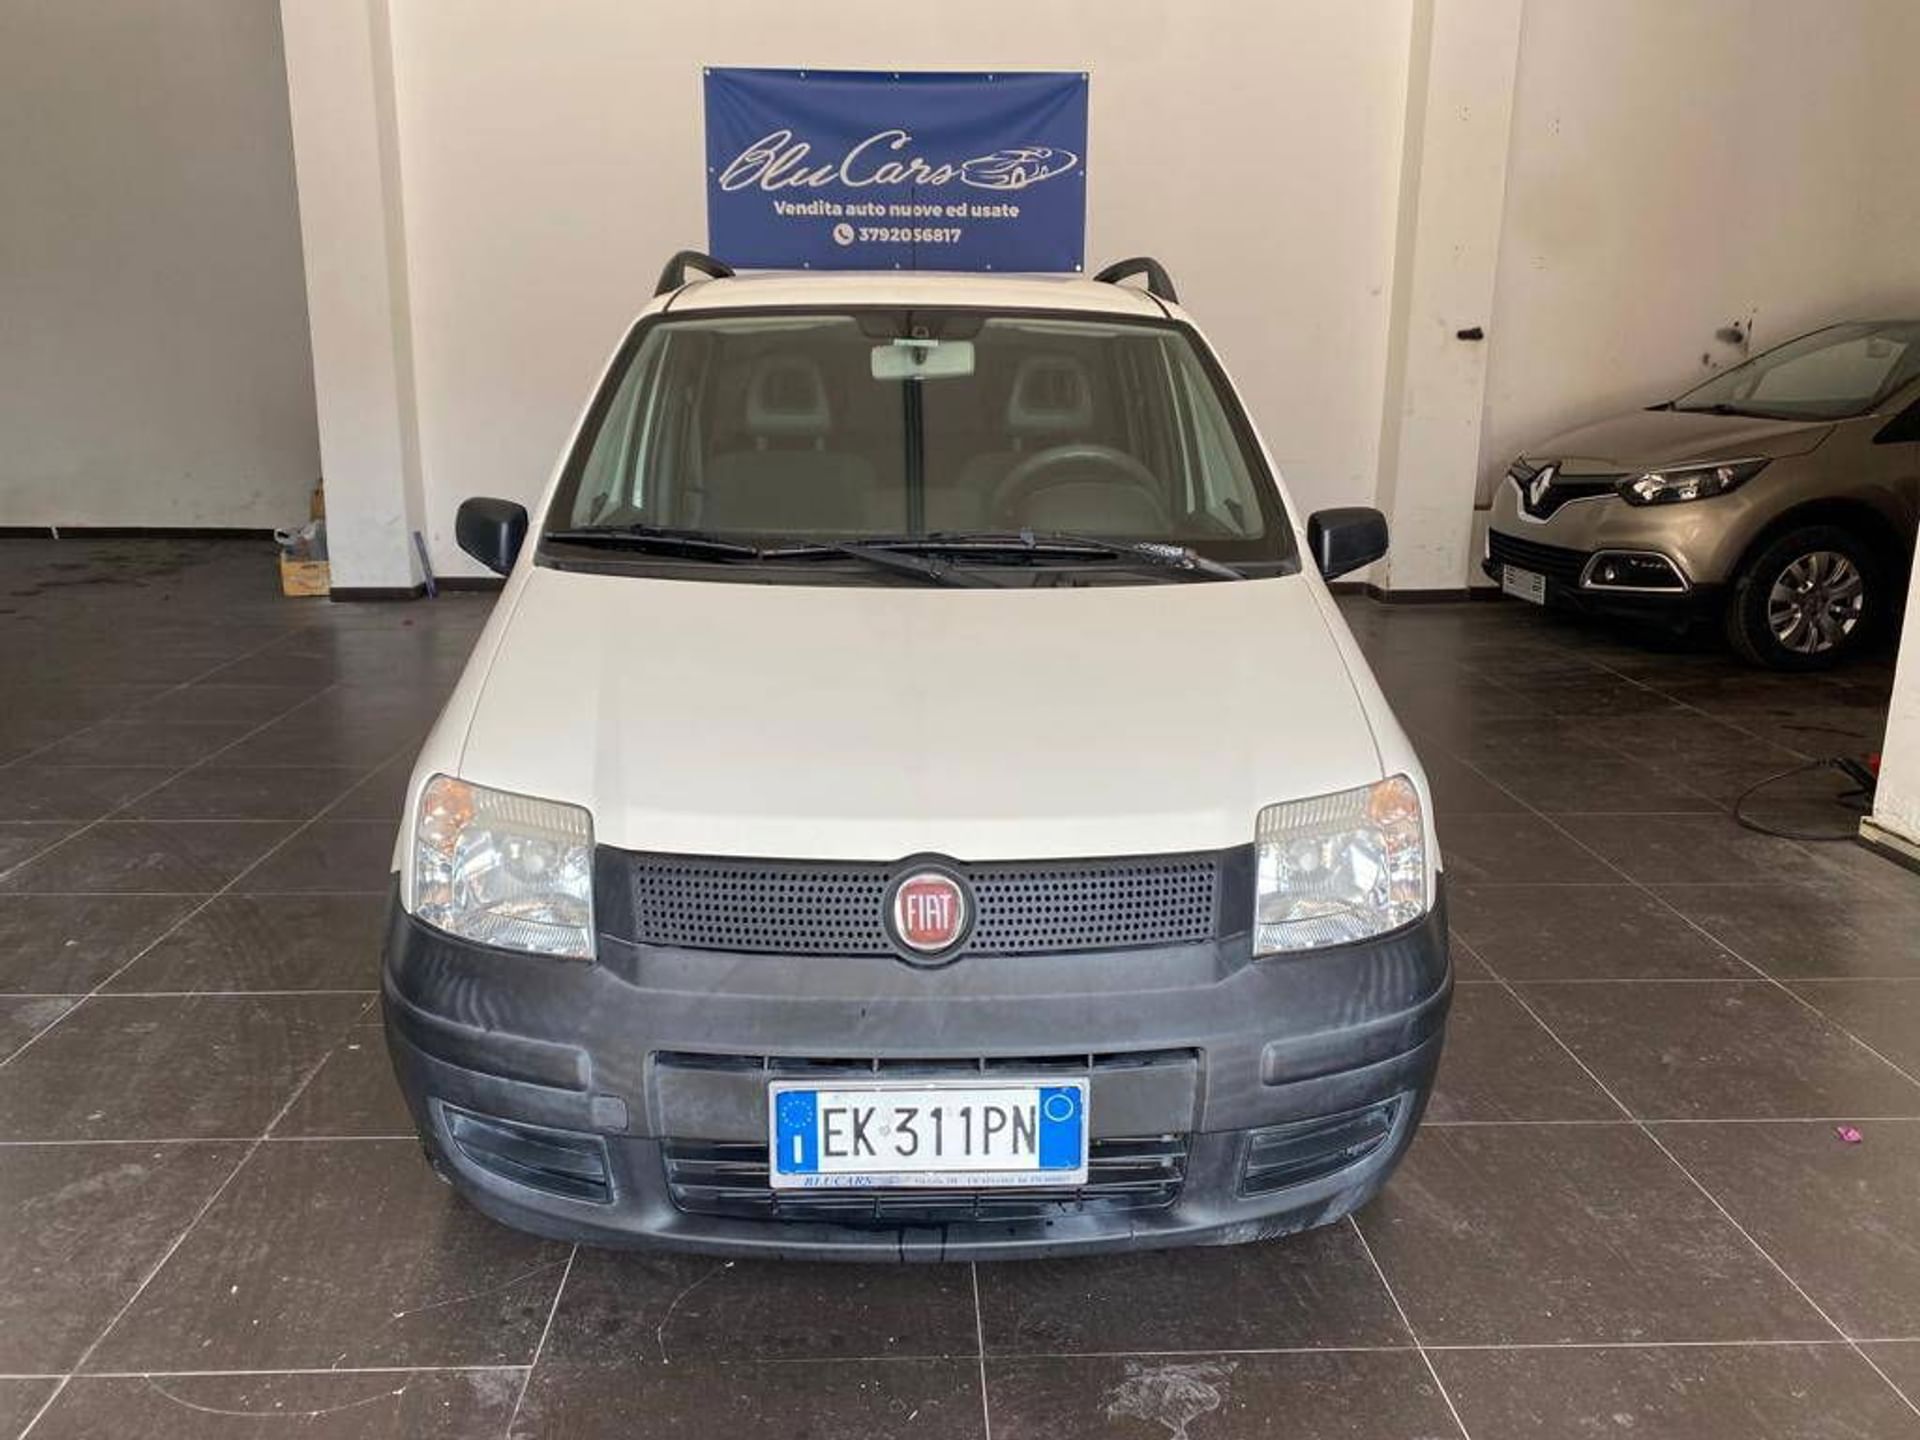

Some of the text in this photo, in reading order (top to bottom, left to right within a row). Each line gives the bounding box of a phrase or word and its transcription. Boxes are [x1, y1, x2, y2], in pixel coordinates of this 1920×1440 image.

[719, 130, 961, 191] Blu Cars
[774, 199, 1020, 218] Vendita auto nuove ed usate
[859, 227, 961, 243] 3792056817
[907, 893, 952, 931] FIAT
[823, 1106, 1036, 1157] EK 311PN
